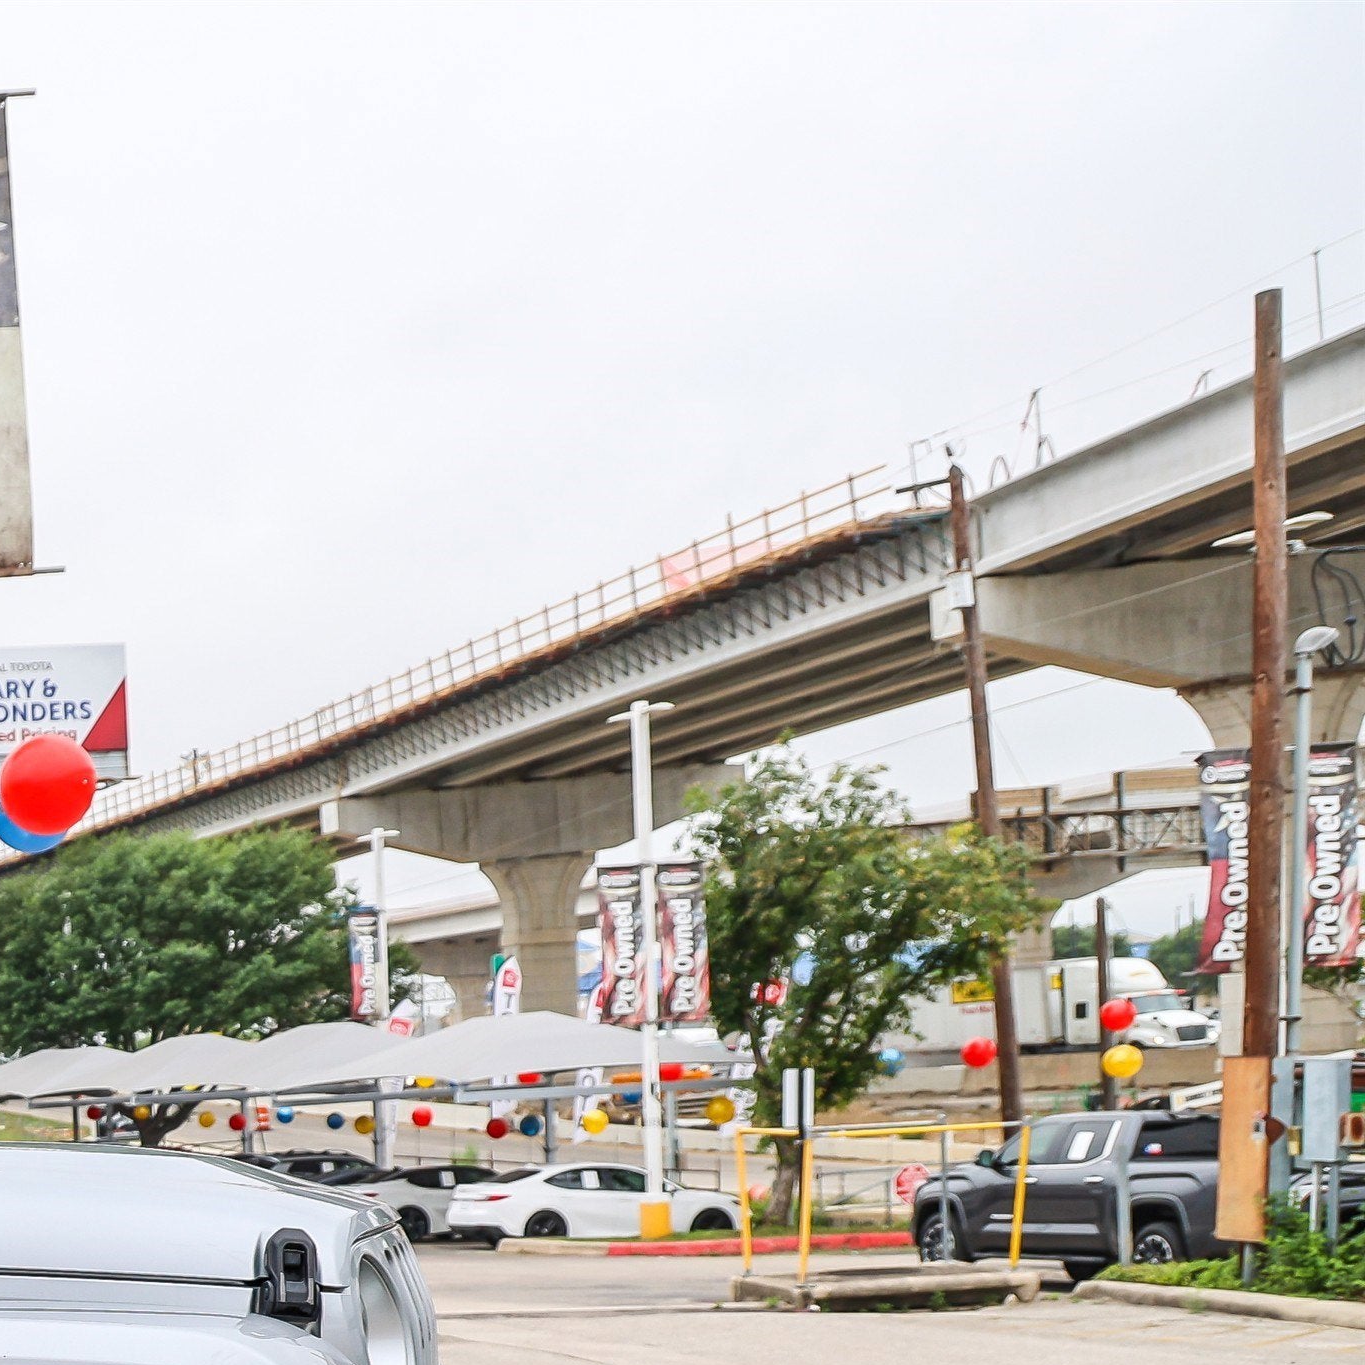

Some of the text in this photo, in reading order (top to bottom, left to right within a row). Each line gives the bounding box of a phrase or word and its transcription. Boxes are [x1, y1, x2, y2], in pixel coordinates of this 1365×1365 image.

[10, 660, 54, 672] TOYOTA
[42, 678, 58, 698] &
[1219, 801, 1249, 907] Owned
[1309, 795, 1341, 899] Owned
[608, 900, 635, 976] Owned
[669, 898, 695, 974] Owned
[1213, 910, 1248, 962] Pre
[1307, 902, 1340, 956] Pre
[611, 976, 636, 1015] Pre
[670, 976, 695, 1013] Pre
